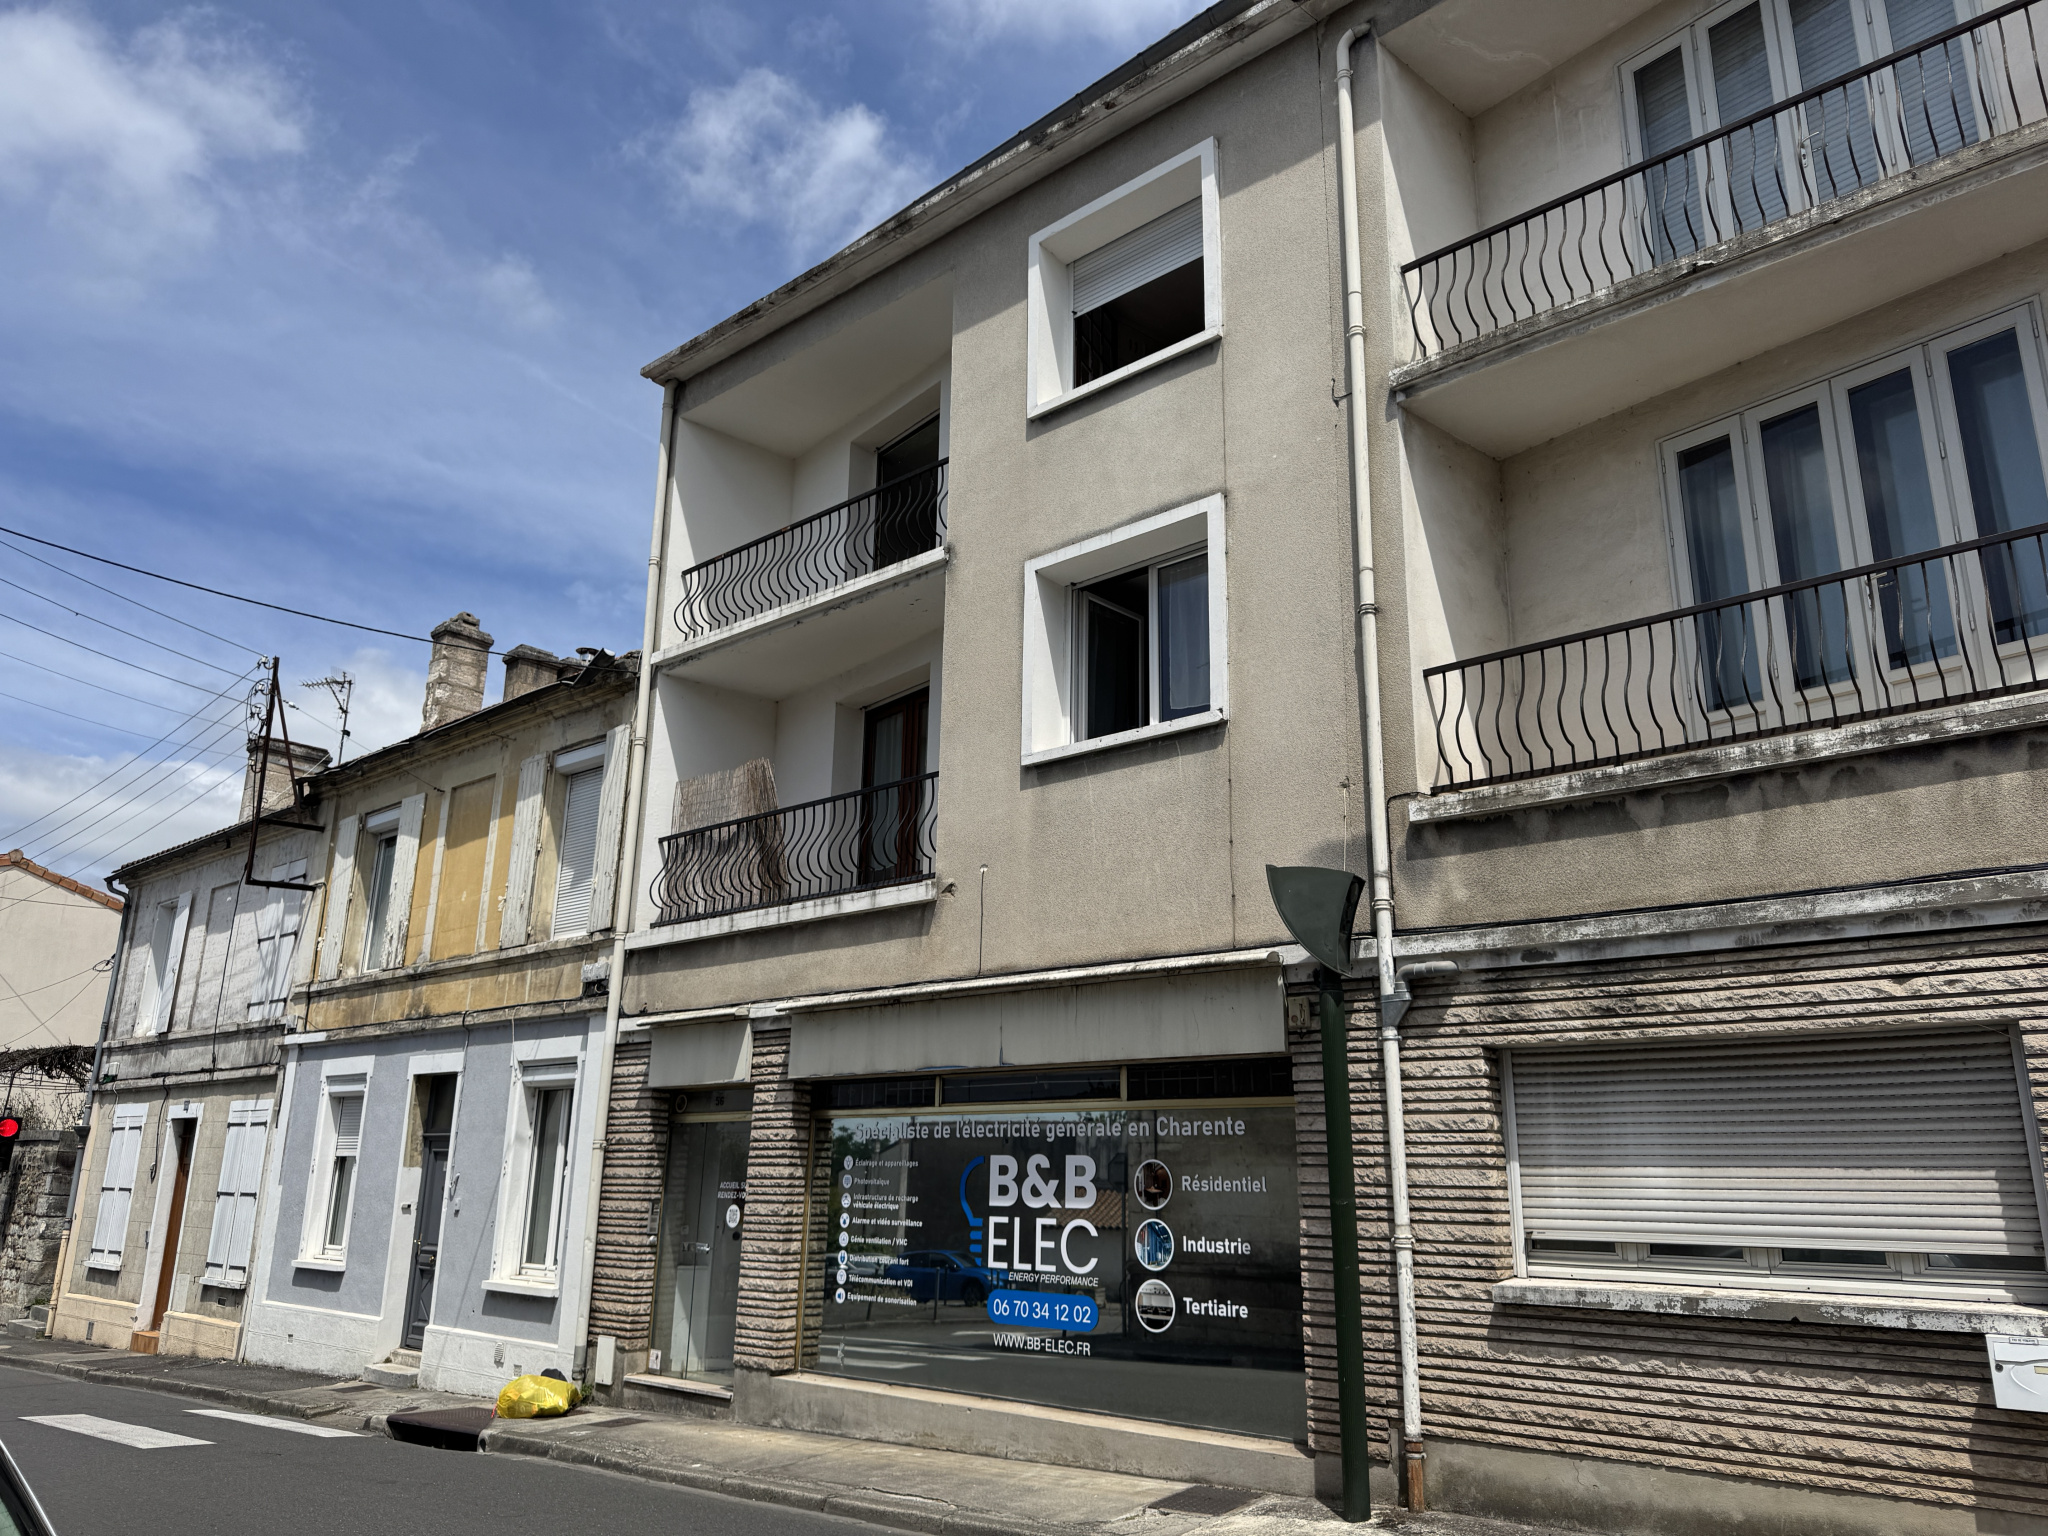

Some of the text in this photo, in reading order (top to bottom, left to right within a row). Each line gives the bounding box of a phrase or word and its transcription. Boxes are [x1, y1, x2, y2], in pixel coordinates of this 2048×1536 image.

[715, 1096, 725, 1106] 56
[855, 1117, 1246, 1142] Spécialiste de l'électricité générale en Charente
[855, 1158, 877, 1168] Éclairage
[885, 1160, 918, 1169] appareillages
[720, 1181, 740, 1189] ACCUEIL
[854, 1178, 890, 1187] Photovoltaïque
[989, 1153, 1097, 1209] B&B
[1181, 1174, 1267, 1192] Résidentiel
[853, 1193, 887, 1201] Infrastructure
[896, 1195, 919, 1204] recharge
[853, 1201, 899, 1211] véhicule électrique
[852, 1217, 869, 1225] Alarme
[877, 1217, 890, 1226] vidéo
[891, 1218, 922, 1228] surveillance
[851, 1236, 864, 1244] Génie
[865, 1237, 891, 1245] ventilation
[988, 1216, 1099, 1275] ELEC
[1182, 1235, 1251, 1255] Industrie
[849, 1254, 909, 1266] Distribution courant fort
[848, 1274, 896, 1285] Télécommunication
[1008, 1271, 1099, 1287] ENERGY PERFORMANCE
[847, 1292, 876, 1302] Equipement
[884, 1297, 917, 1306] sonorisation
[993, 1298, 1092, 1324] 06 70 34 12 02
[1183, 1297, 1249, 1319] Tertiaire
[993, 1333, 1091, 1357] WWW.BB-ELEC.FR
